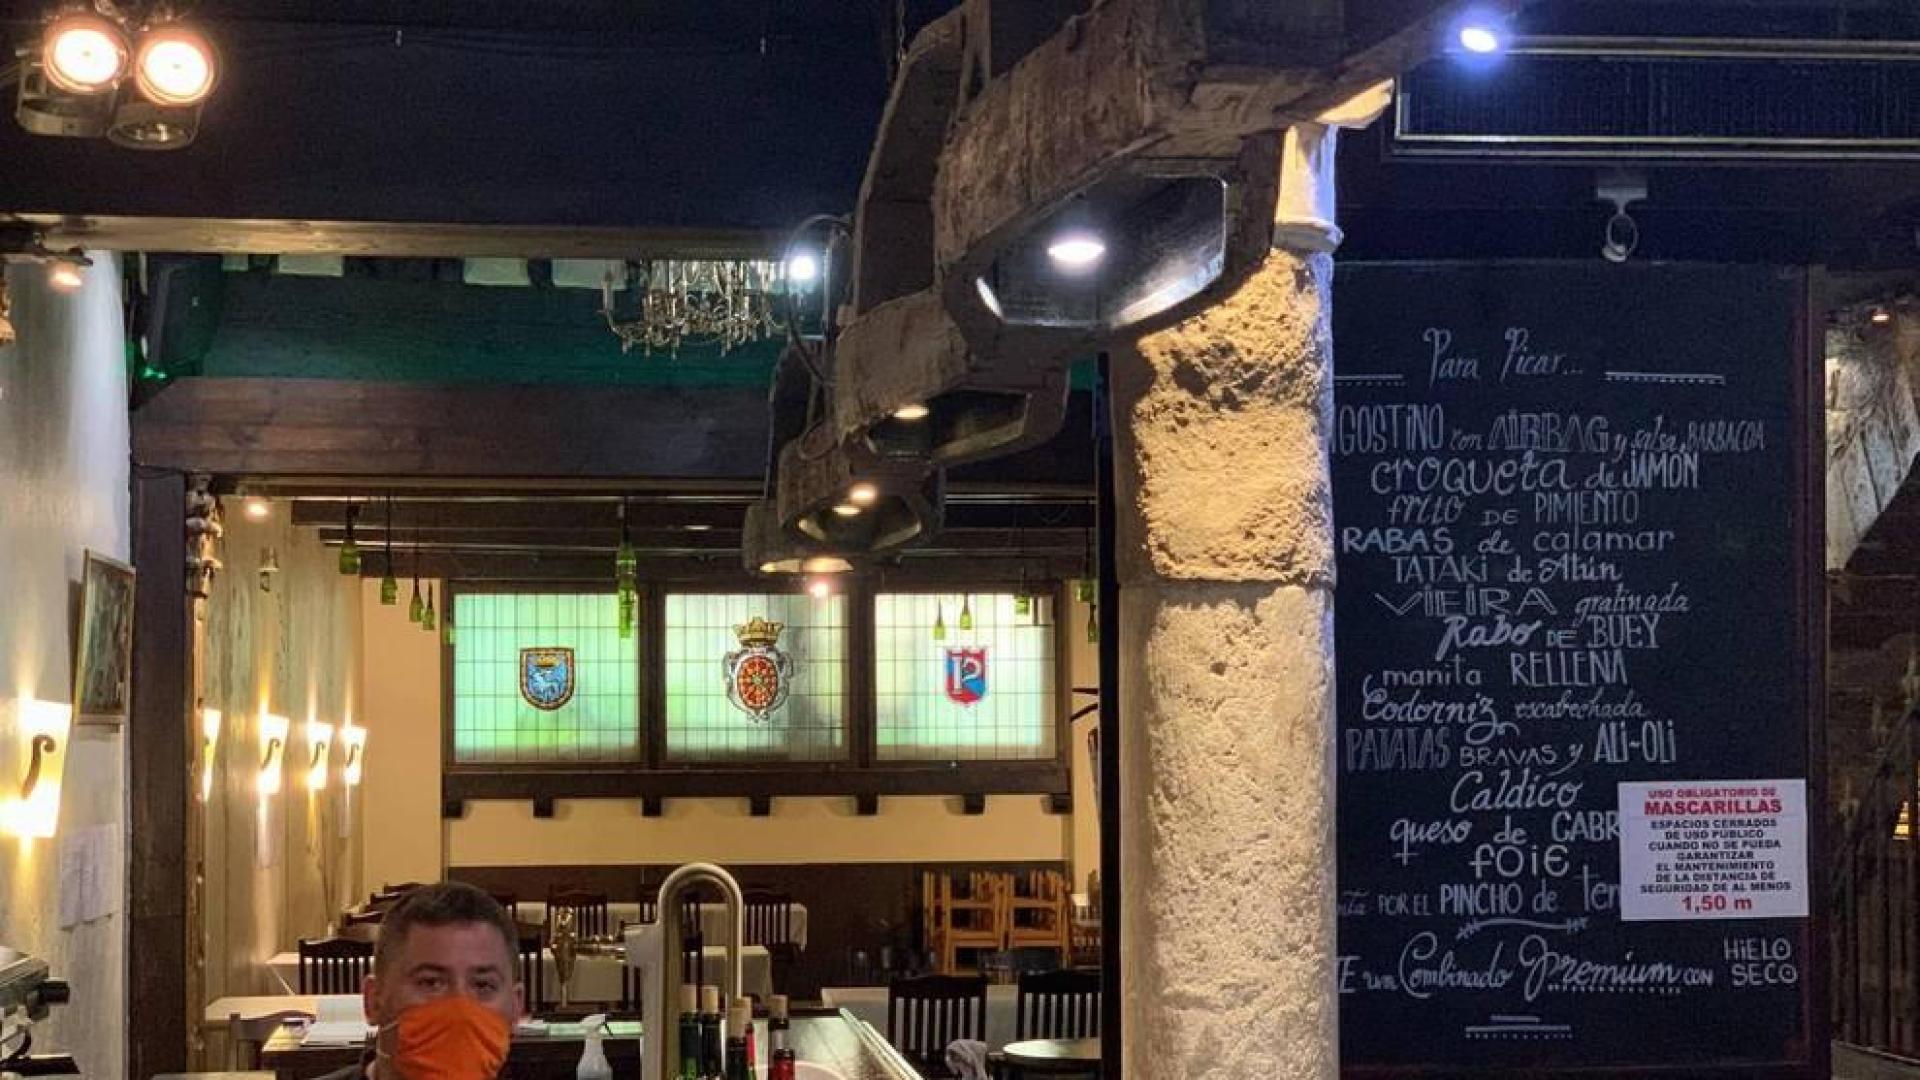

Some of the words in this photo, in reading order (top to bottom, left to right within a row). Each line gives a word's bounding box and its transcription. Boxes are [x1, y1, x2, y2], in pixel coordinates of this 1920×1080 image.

[1423, 327, 1480, 388] Para
[1584, 462, 1620, 489] de
[1535, 489, 1640, 525] PIMIENTO
[1343, 526, 1454, 553] RABAS
[1478, 530, 1514, 554] de
[1533, 523, 1675, 551] calamar
[1435, 616, 1543, 662] Rabo
[1547, 630, 1578, 648] DE
[1586, 613, 1660, 649] BUEY
[1382, 654, 1482, 686] manita
[1511, 650, 1628, 687] RELLENA
[1345, 726, 1450, 771] PATATAS
[1460, 744, 1557, 767] BRAVAS
[1450, 768, 1584, 813] Caldico
[1648, 790, 1673, 798] USO
[1677, 788, 1758, 798] OBLIGATORIO
[1762, 787, 1777, 796] DE
[1644, 799, 1783, 815] MASCARILLAS
[1651, 820, 1709, 829] ESPACIOS
[1713, 819, 1777, 828] CERRADOS
[1665, 831, 1680, 840] DE
[1685, 831, 1709, 839] USO
[1389, 818, 1473, 866] queso
[1493, 815, 1527, 845] de
[1648, 842, 1699, 851] CUANDO
[1702, 841, 1719, 850] NO
[1724, 841, 1738, 849] SE
[1742, 839, 1782, 849] PUEDA
[1656, 863, 1671, 871] EL
[1675, 861, 1775, 871] MANTENIMIENTO
[1677, 851, 1754, 860] GARANTIZAR
[1640, 884, 1709, 893] SEGURIDAD
[1712, 883, 1728, 891] DE
[1732, 883, 1747, 891] AL
[1751, 882, 1791, 891] MENOS
[1656, 873, 1672, 882] DE
[1675, 873, 1690, 882] LA
[1693, 872, 1757, 881] DISTANCIA
[1761, 872, 1776, 880] DE
[1440, 883, 1523, 915] PINCHO
[1532, 878, 1560, 913] de
[1682, 895, 1727, 912] 1,50
[1734, 898, 1752, 910] m
[1731, 963, 1798, 986] SECO
